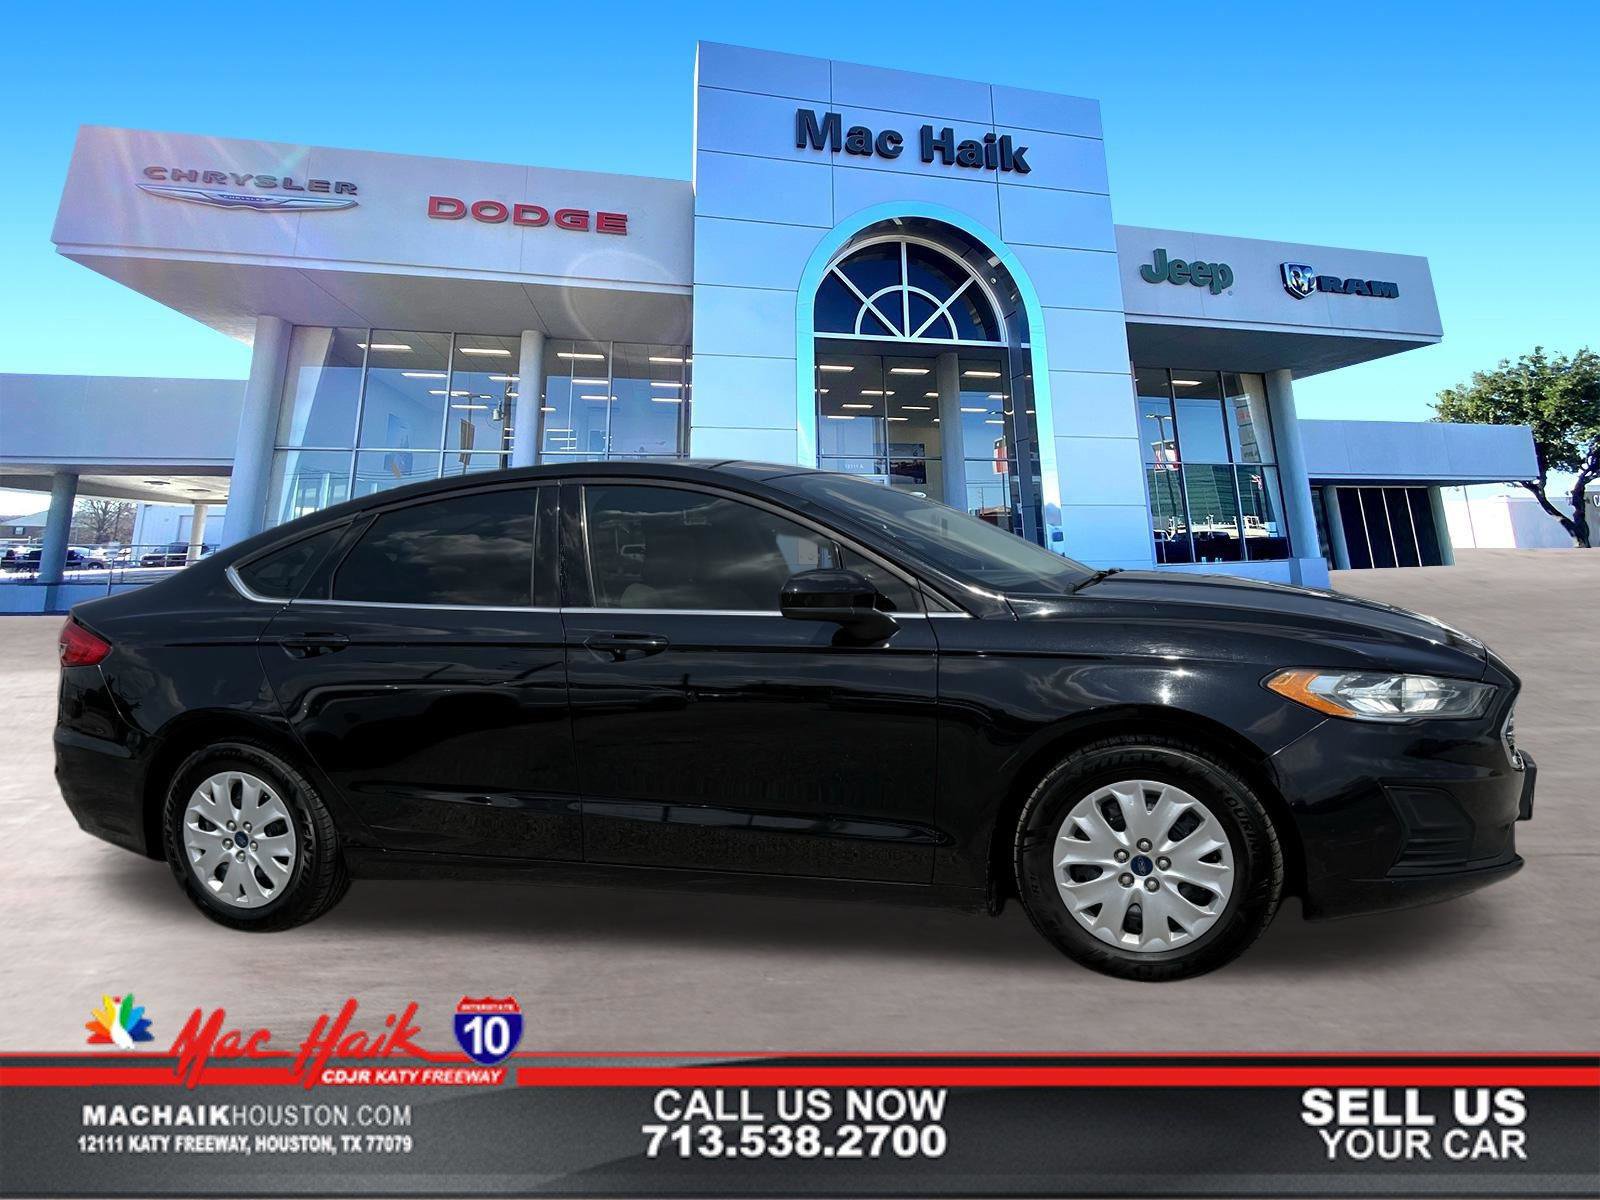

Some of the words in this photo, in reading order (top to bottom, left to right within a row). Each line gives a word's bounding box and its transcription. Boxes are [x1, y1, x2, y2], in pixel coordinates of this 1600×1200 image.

[795, 108, 904, 160] Mac
[920, 124, 1032, 174] Haik
[143, 166, 359, 196] CHRYSLER
[428, 196, 628, 236] DODGE
[1140, 248, 1234, 295] Jeep
[1315, 275, 1400, 299] RAM
